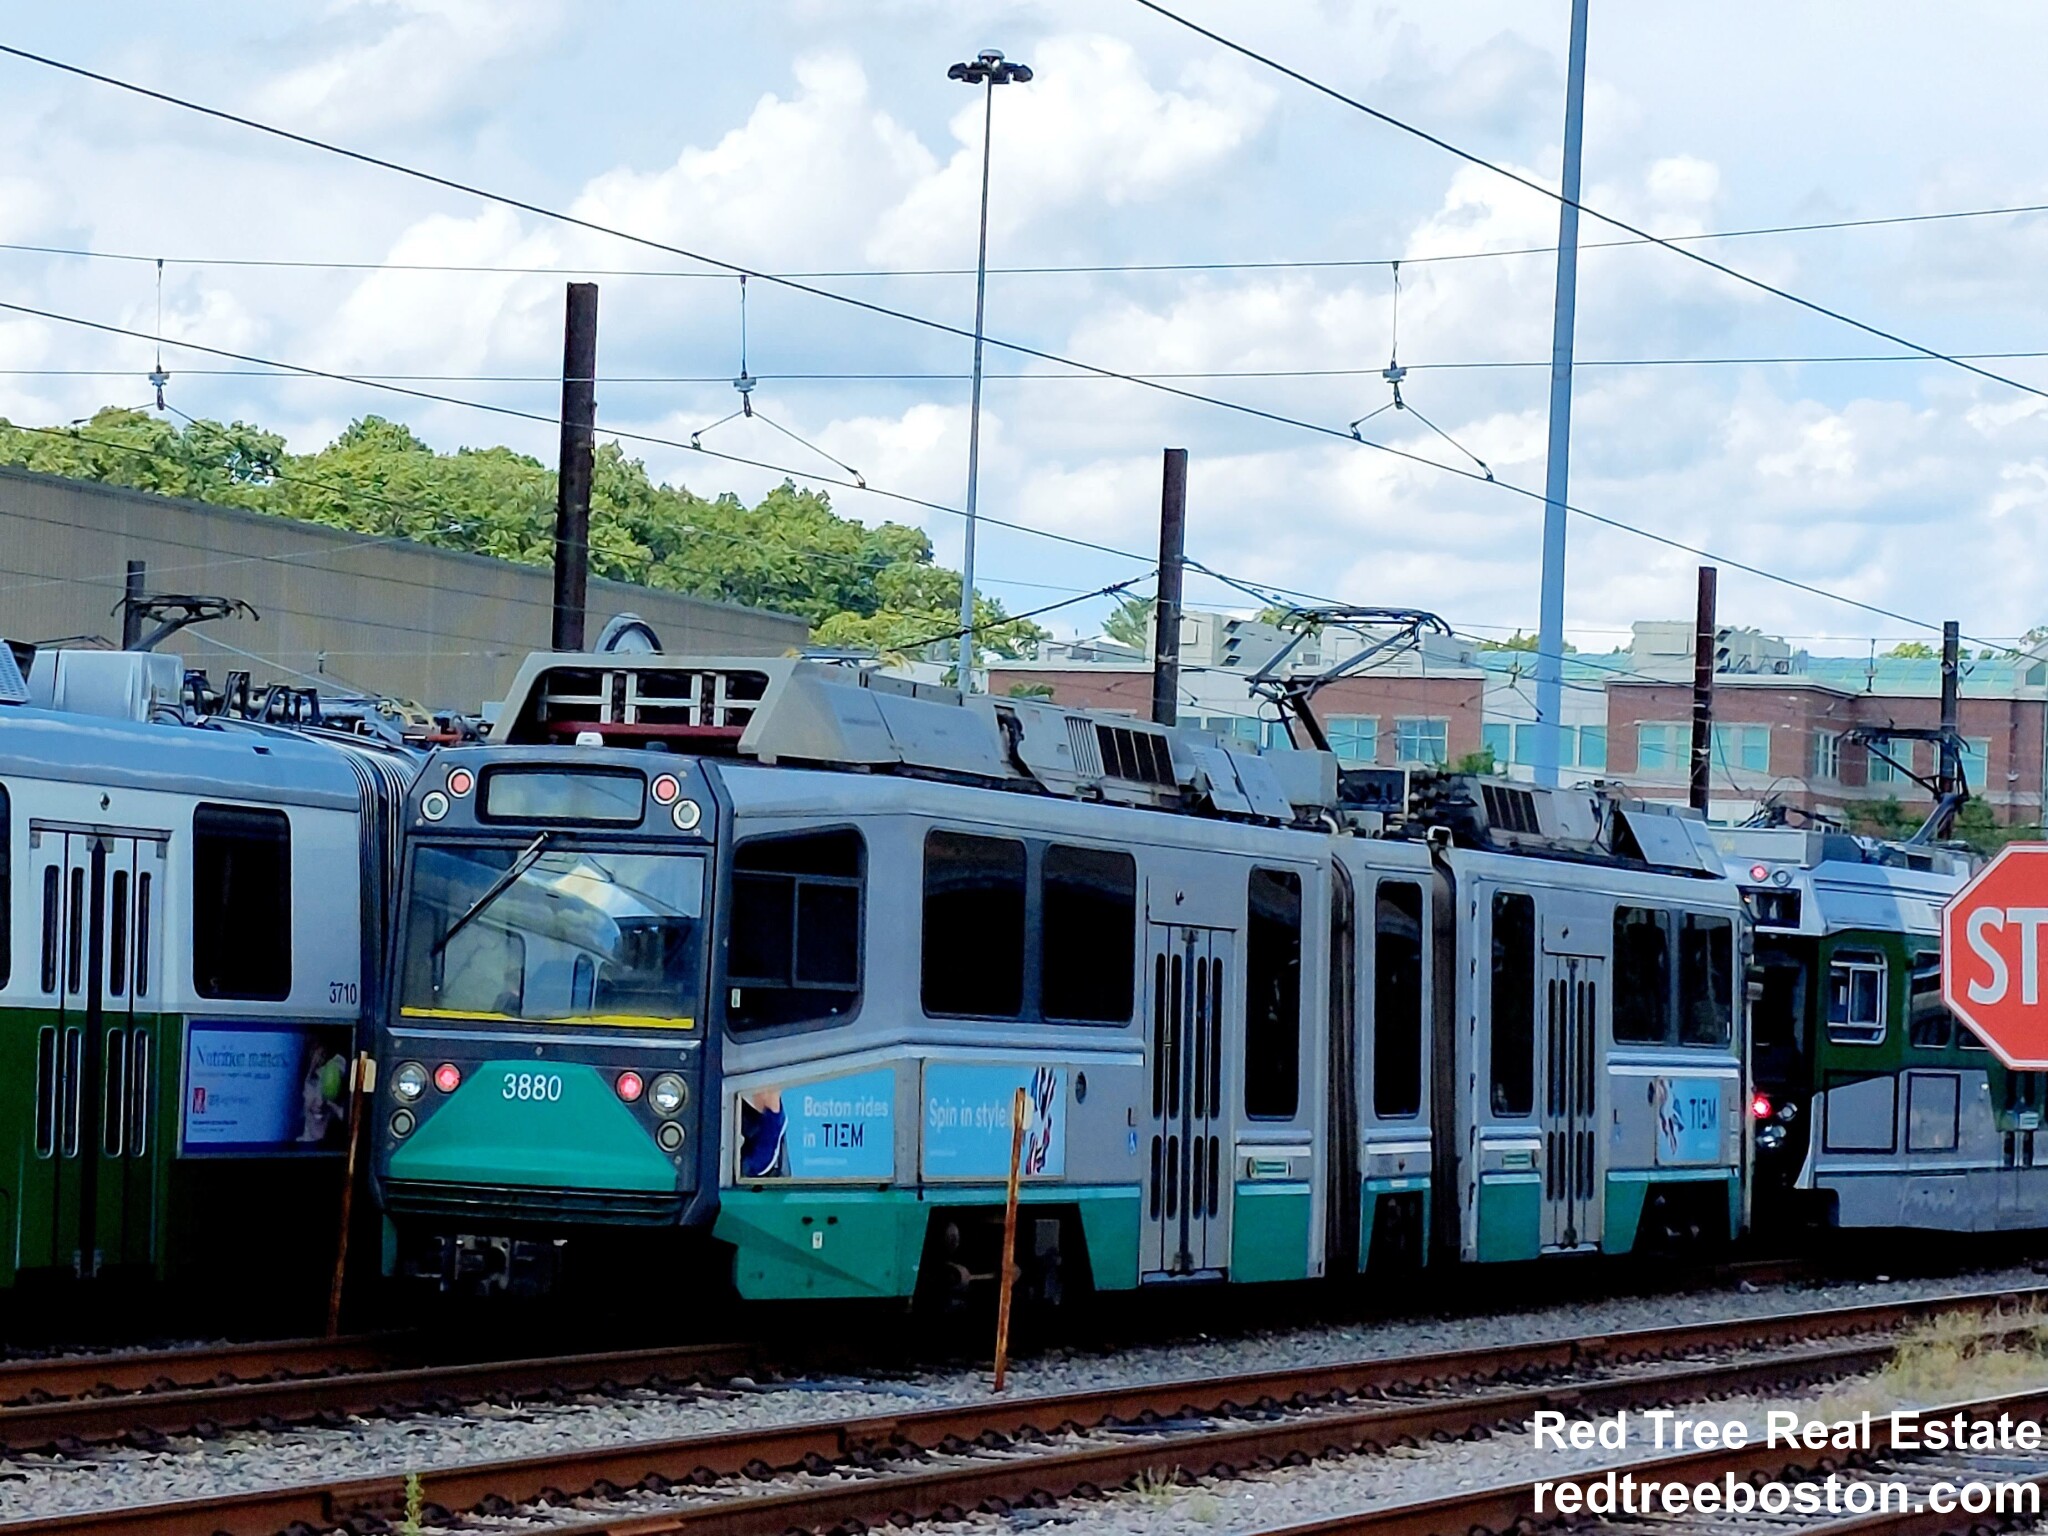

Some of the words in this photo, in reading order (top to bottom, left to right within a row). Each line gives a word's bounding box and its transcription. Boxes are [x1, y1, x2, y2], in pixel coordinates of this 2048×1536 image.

[329, 981, 357, 1005] 3710
[503, 1073, 562, 1101] 3880
[804, 1096, 851, 1117] Boston
[855, 1096, 889, 1117] rides
[929, 1097, 957, 1134] Spin
[961, 1098, 973, 1127] in
[975, 1099, 1006, 1134] style
[1690, 1097, 1717, 1130] TIEM
[803, 1127, 816, 1147] in
[822, 1123, 865, 1148] TIEM
